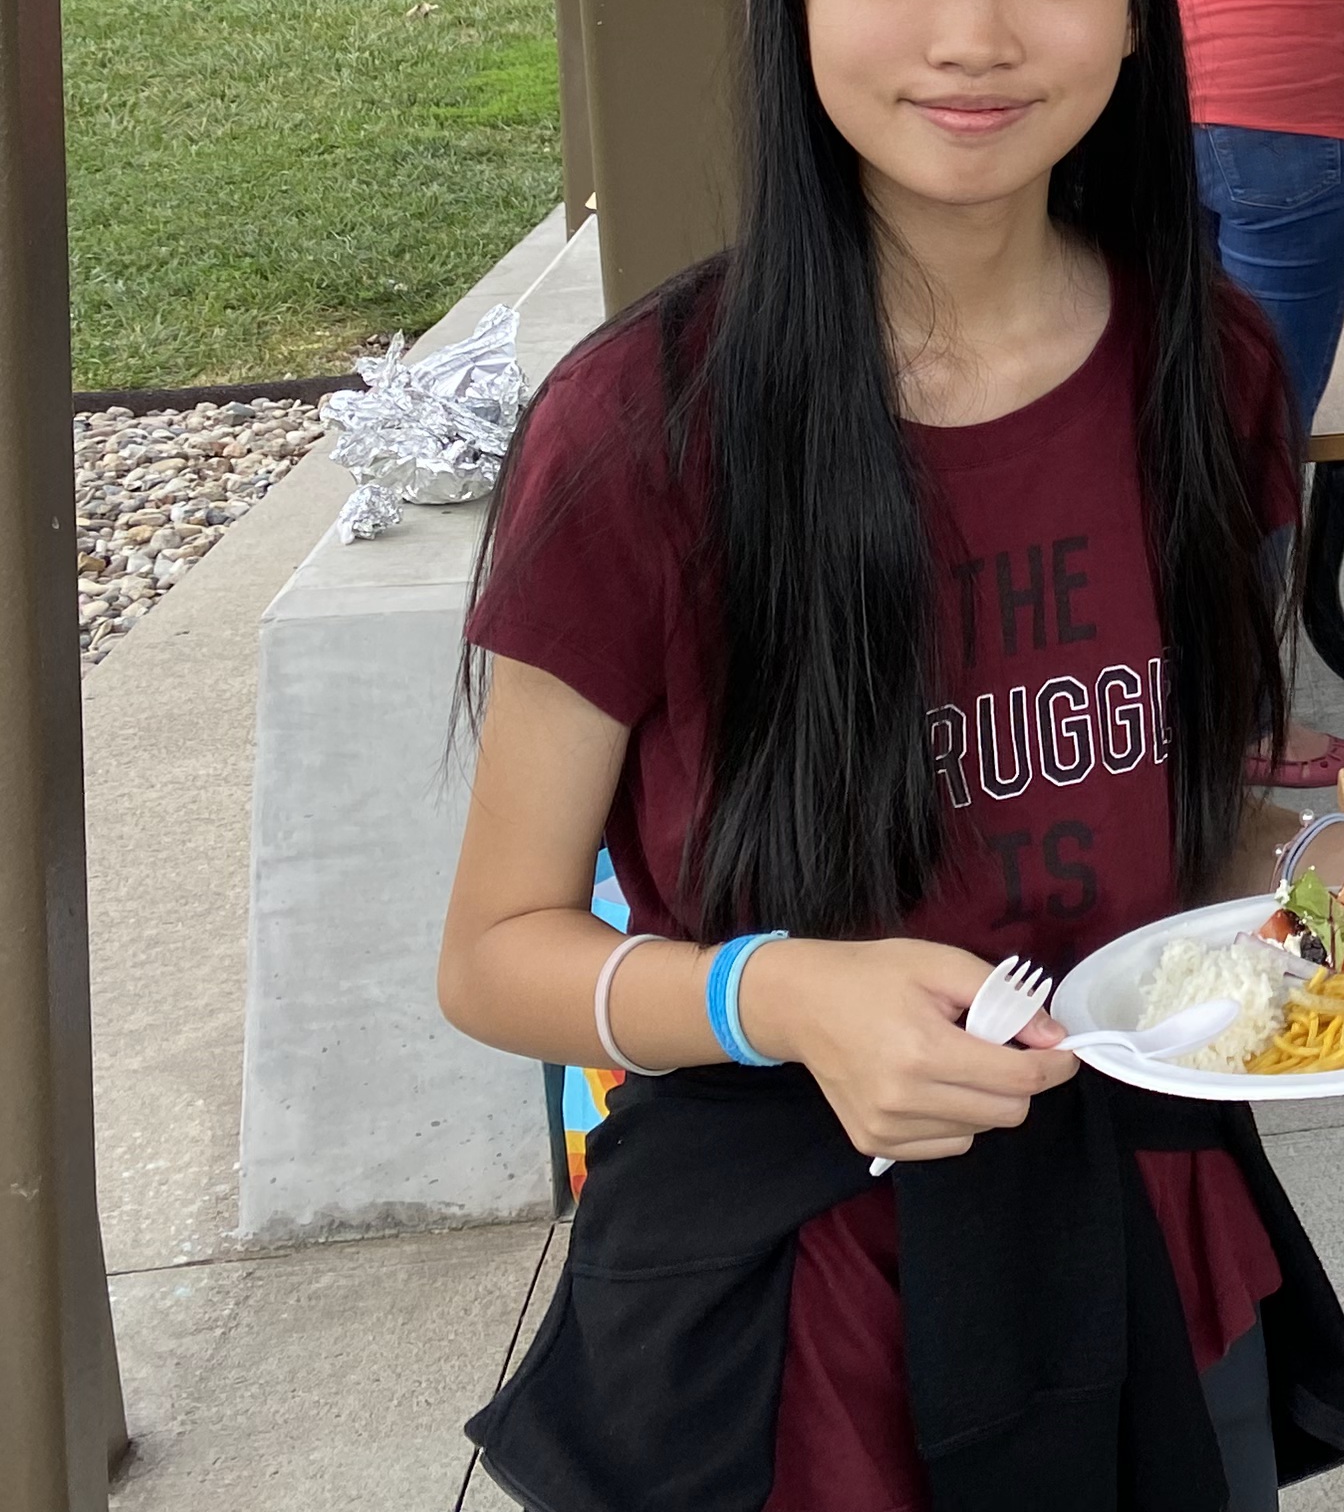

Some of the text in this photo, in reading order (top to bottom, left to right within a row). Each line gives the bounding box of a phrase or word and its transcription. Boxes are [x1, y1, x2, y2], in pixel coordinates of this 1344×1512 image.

[953, 534, 1097, 669] THE
[926, 657, 1176, 810] RUGGL
[985, 819, 1098, 930] IS
